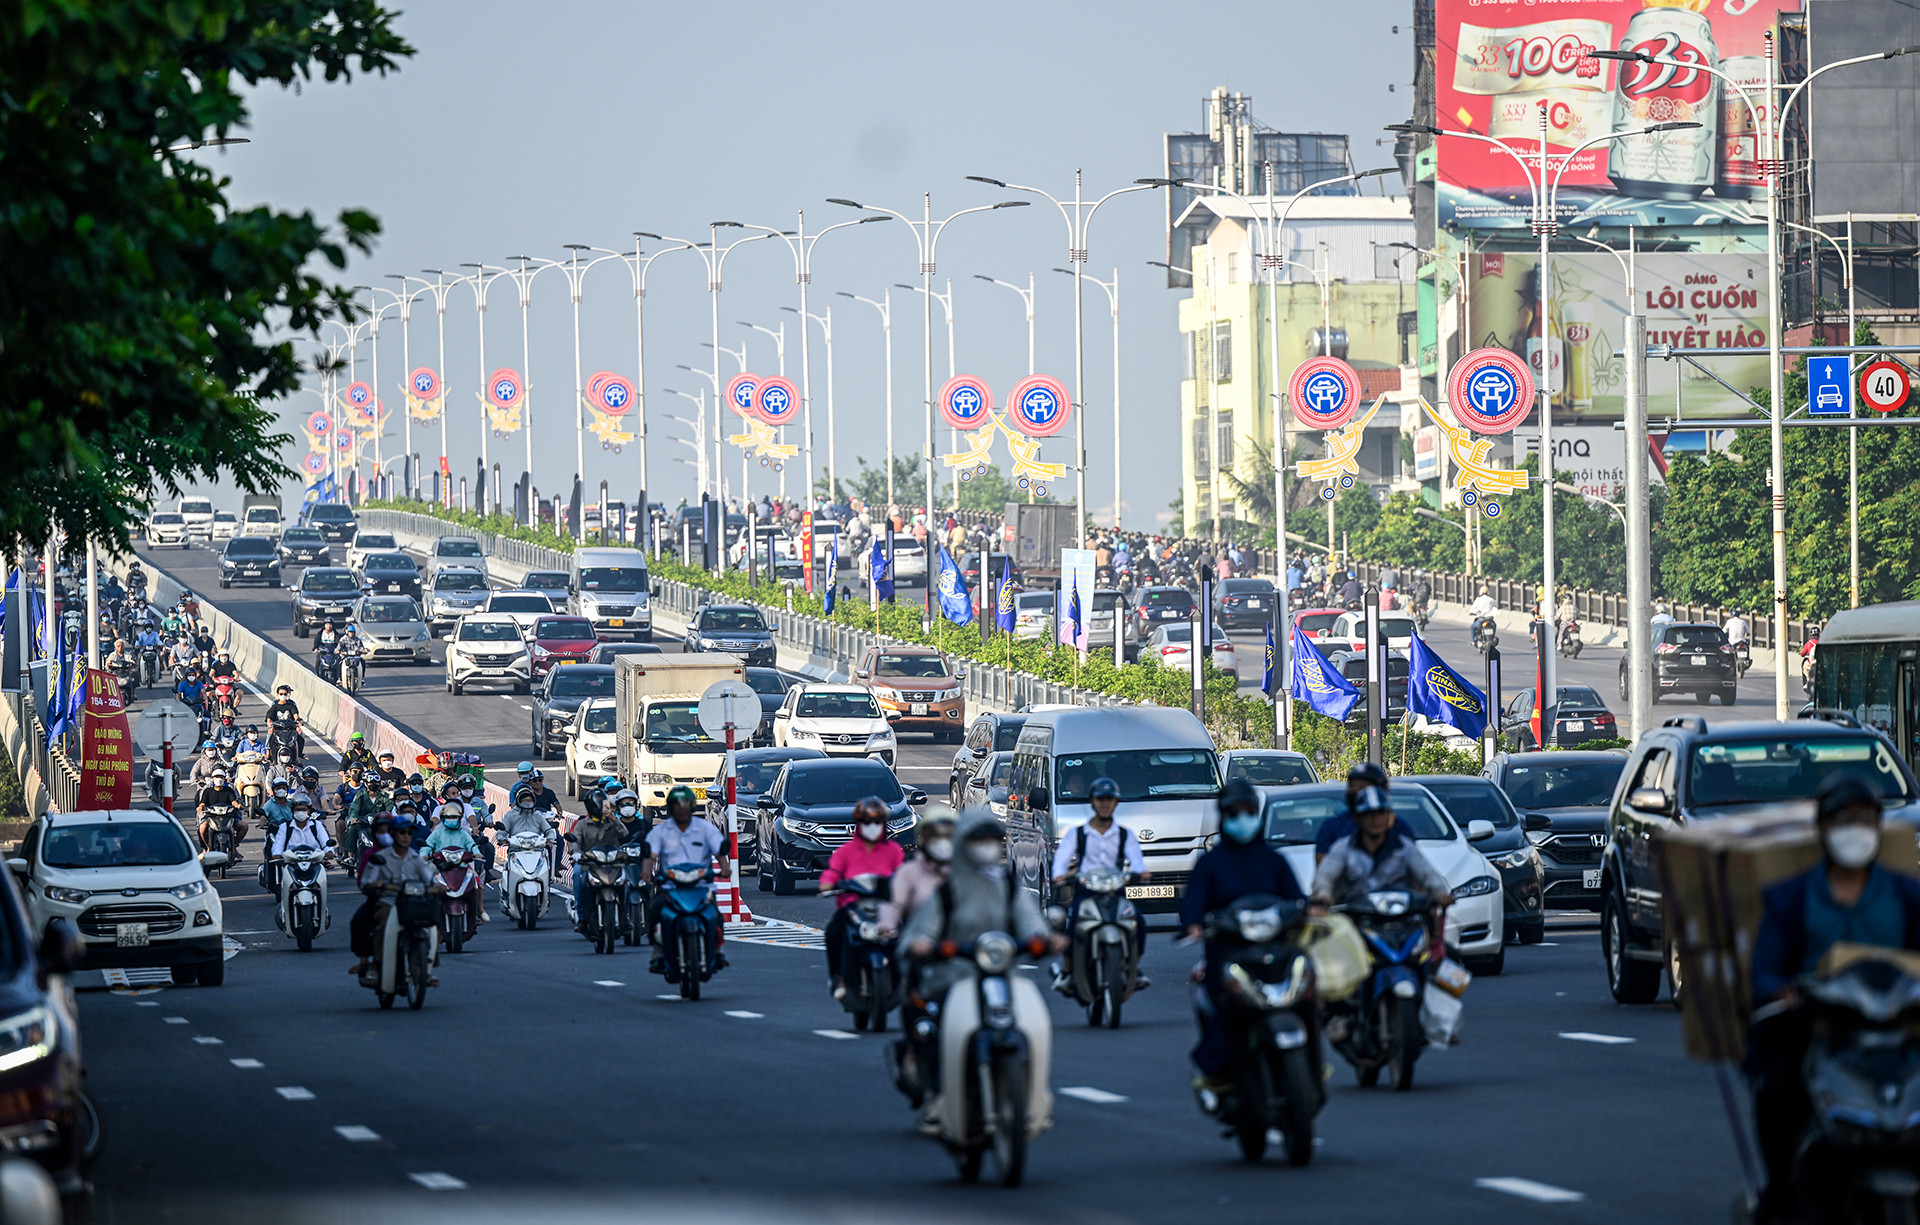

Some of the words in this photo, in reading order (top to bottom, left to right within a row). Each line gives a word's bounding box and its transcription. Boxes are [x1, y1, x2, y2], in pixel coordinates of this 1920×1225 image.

[1505, 35, 1583, 76] 100
[1623, 31, 1700, 96] 333
[1502, 103, 1527, 117] 333
[1684, 272, 1718, 285] DÁNG
[1646, 285, 1684, 309] LÔI
[1690, 283, 1758, 309] CUỐN
[1695, 313, 1708, 326] VỊ
[1717, 324, 1766, 348] HẢO
[1875, 377, 1894, 397] 40
[1598, 466, 1624, 480] thất
[91, 674, 118, 697] 10-10
[1127, 887, 1173, 897] 29B-189.38
[124, 924, 141, 935] 30E
